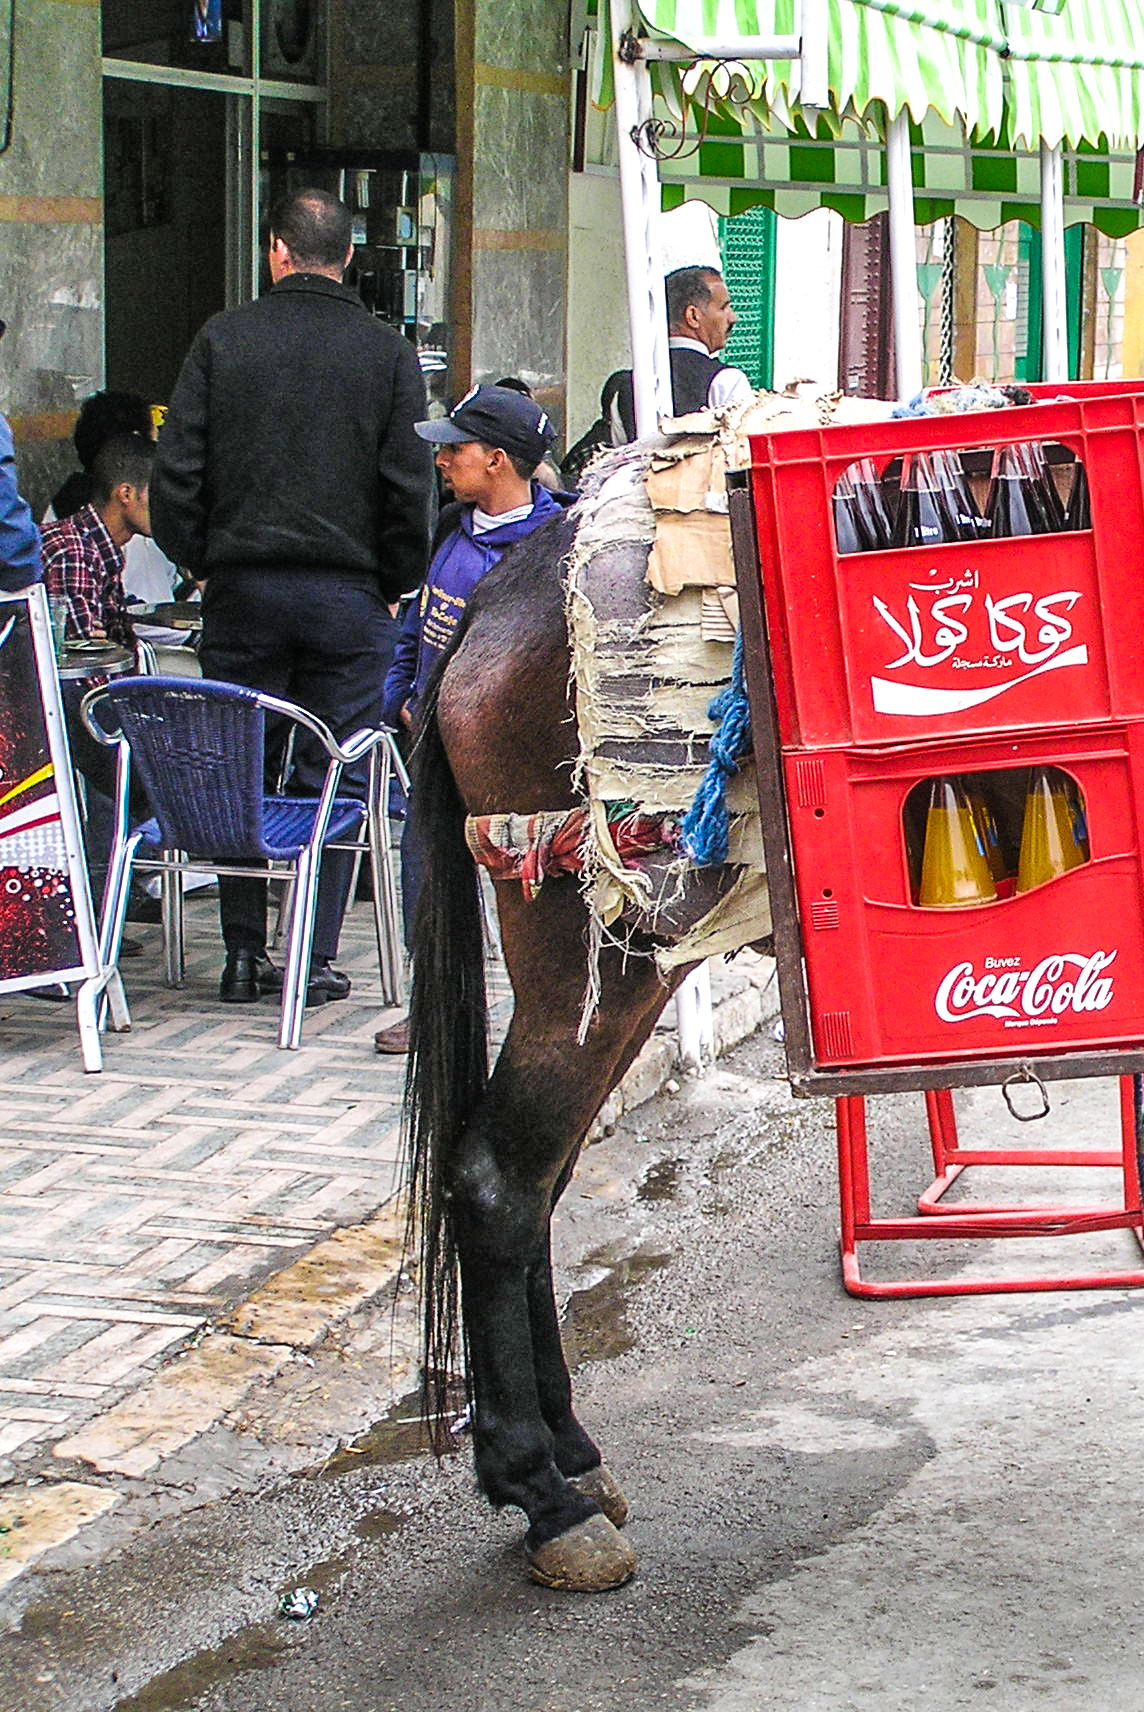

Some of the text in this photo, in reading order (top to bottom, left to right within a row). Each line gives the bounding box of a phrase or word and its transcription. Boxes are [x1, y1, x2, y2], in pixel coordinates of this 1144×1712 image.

[872, 591, 1083, 669] كوكا كولا
[934, 949, 1118, 1023] Coca-Cola
[984, 957, 1021, 970] Buvez
